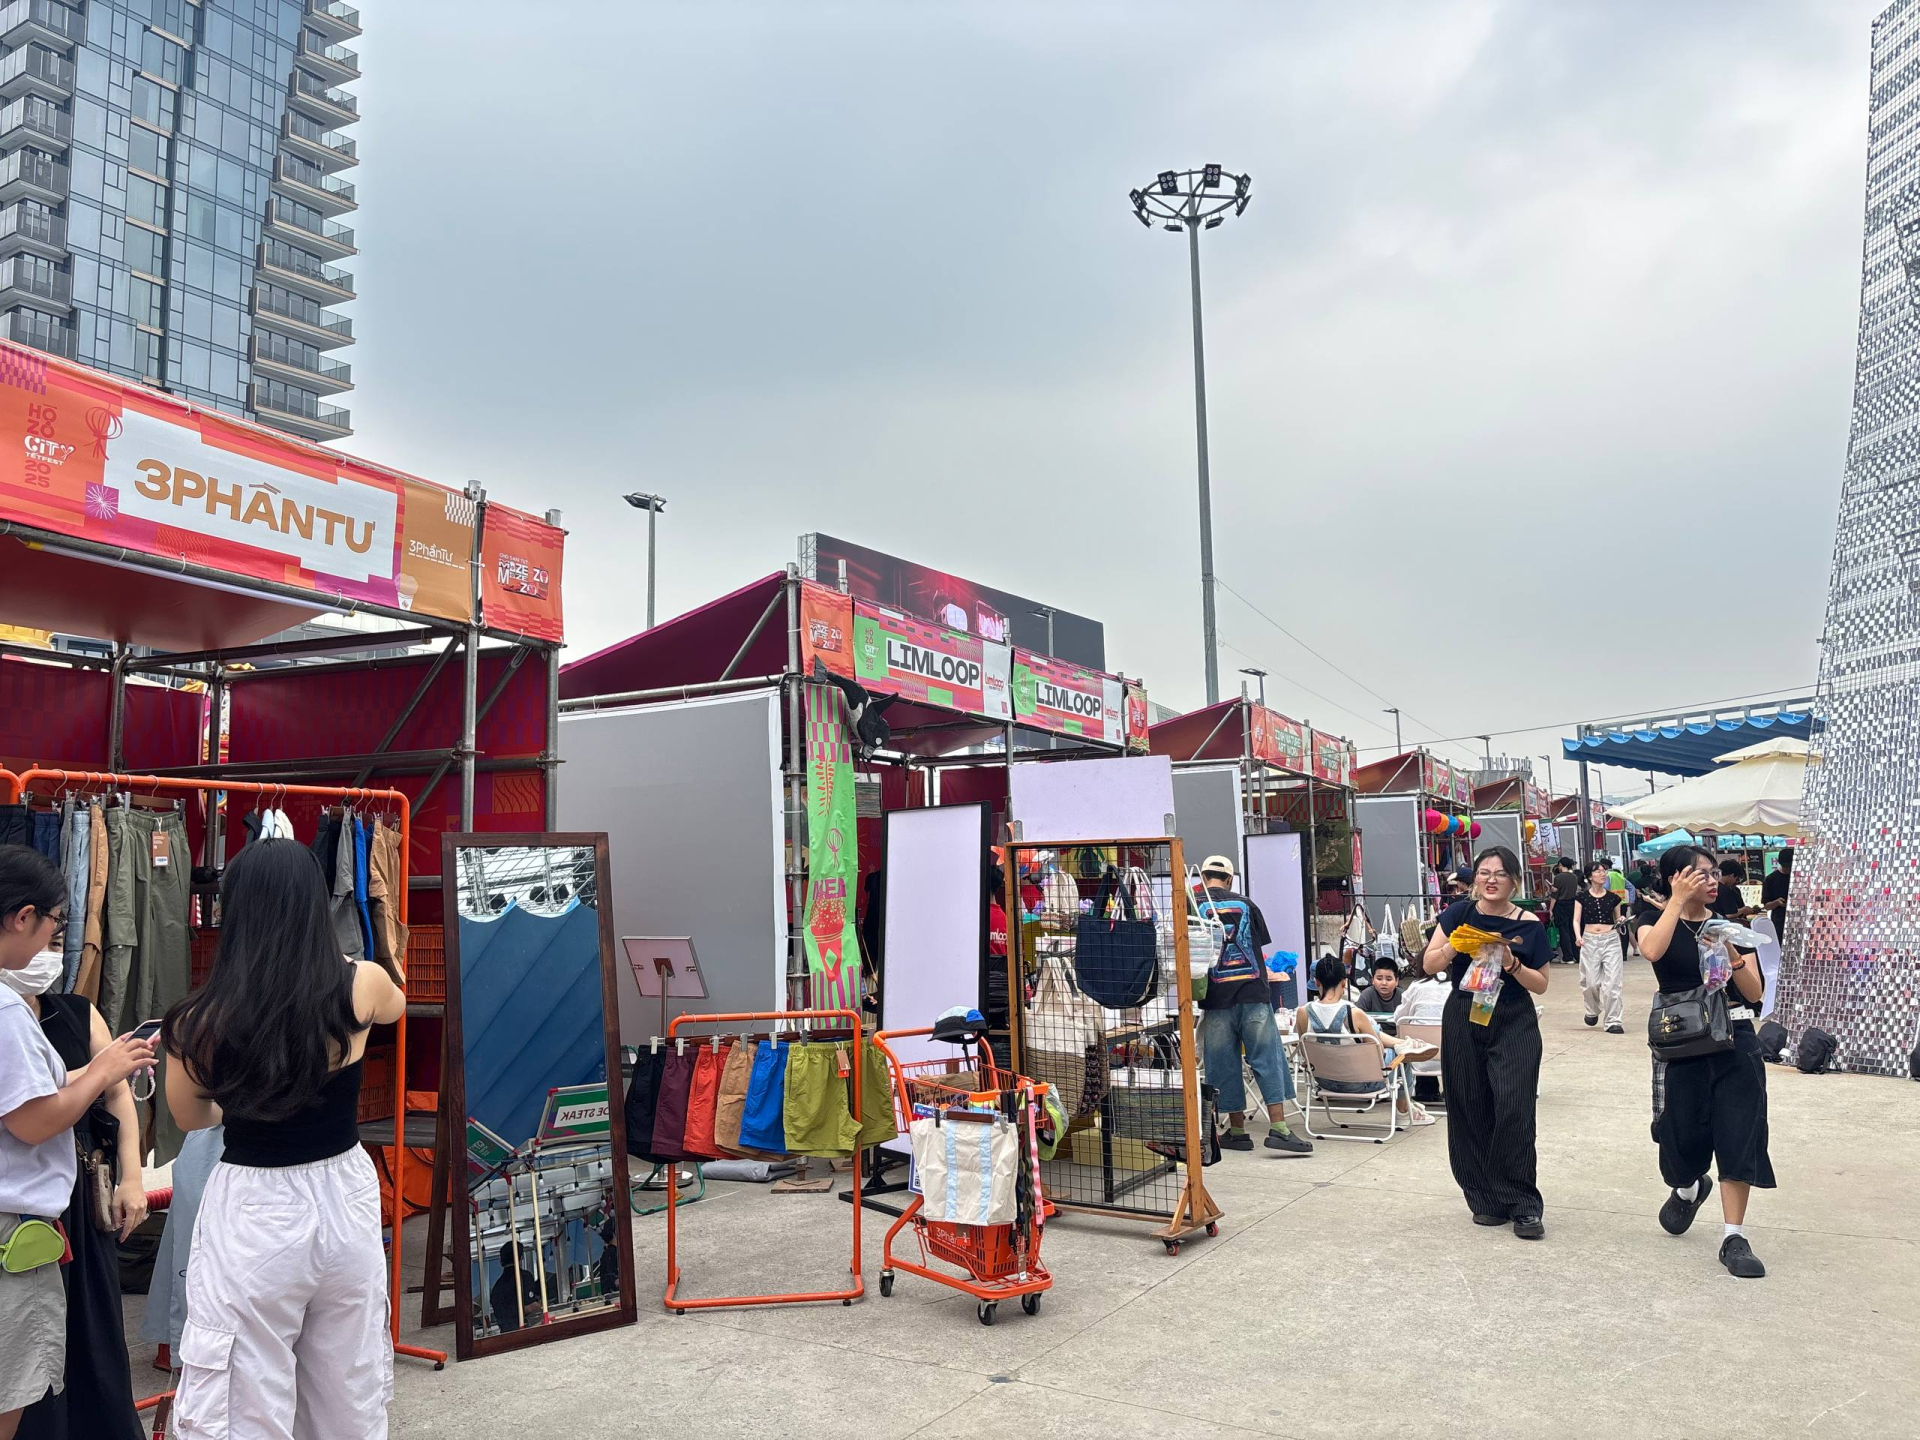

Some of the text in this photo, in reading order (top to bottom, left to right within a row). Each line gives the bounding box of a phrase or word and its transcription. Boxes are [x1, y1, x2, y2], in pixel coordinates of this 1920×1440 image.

[24, 459, 52, 475] 20
[24, 472, 50, 489] 25
[887, 640, 980, 686] LIMLOOP
[1035, 682, 1101, 717] LIMLOOP
[989, 927, 1008, 941] mloo
